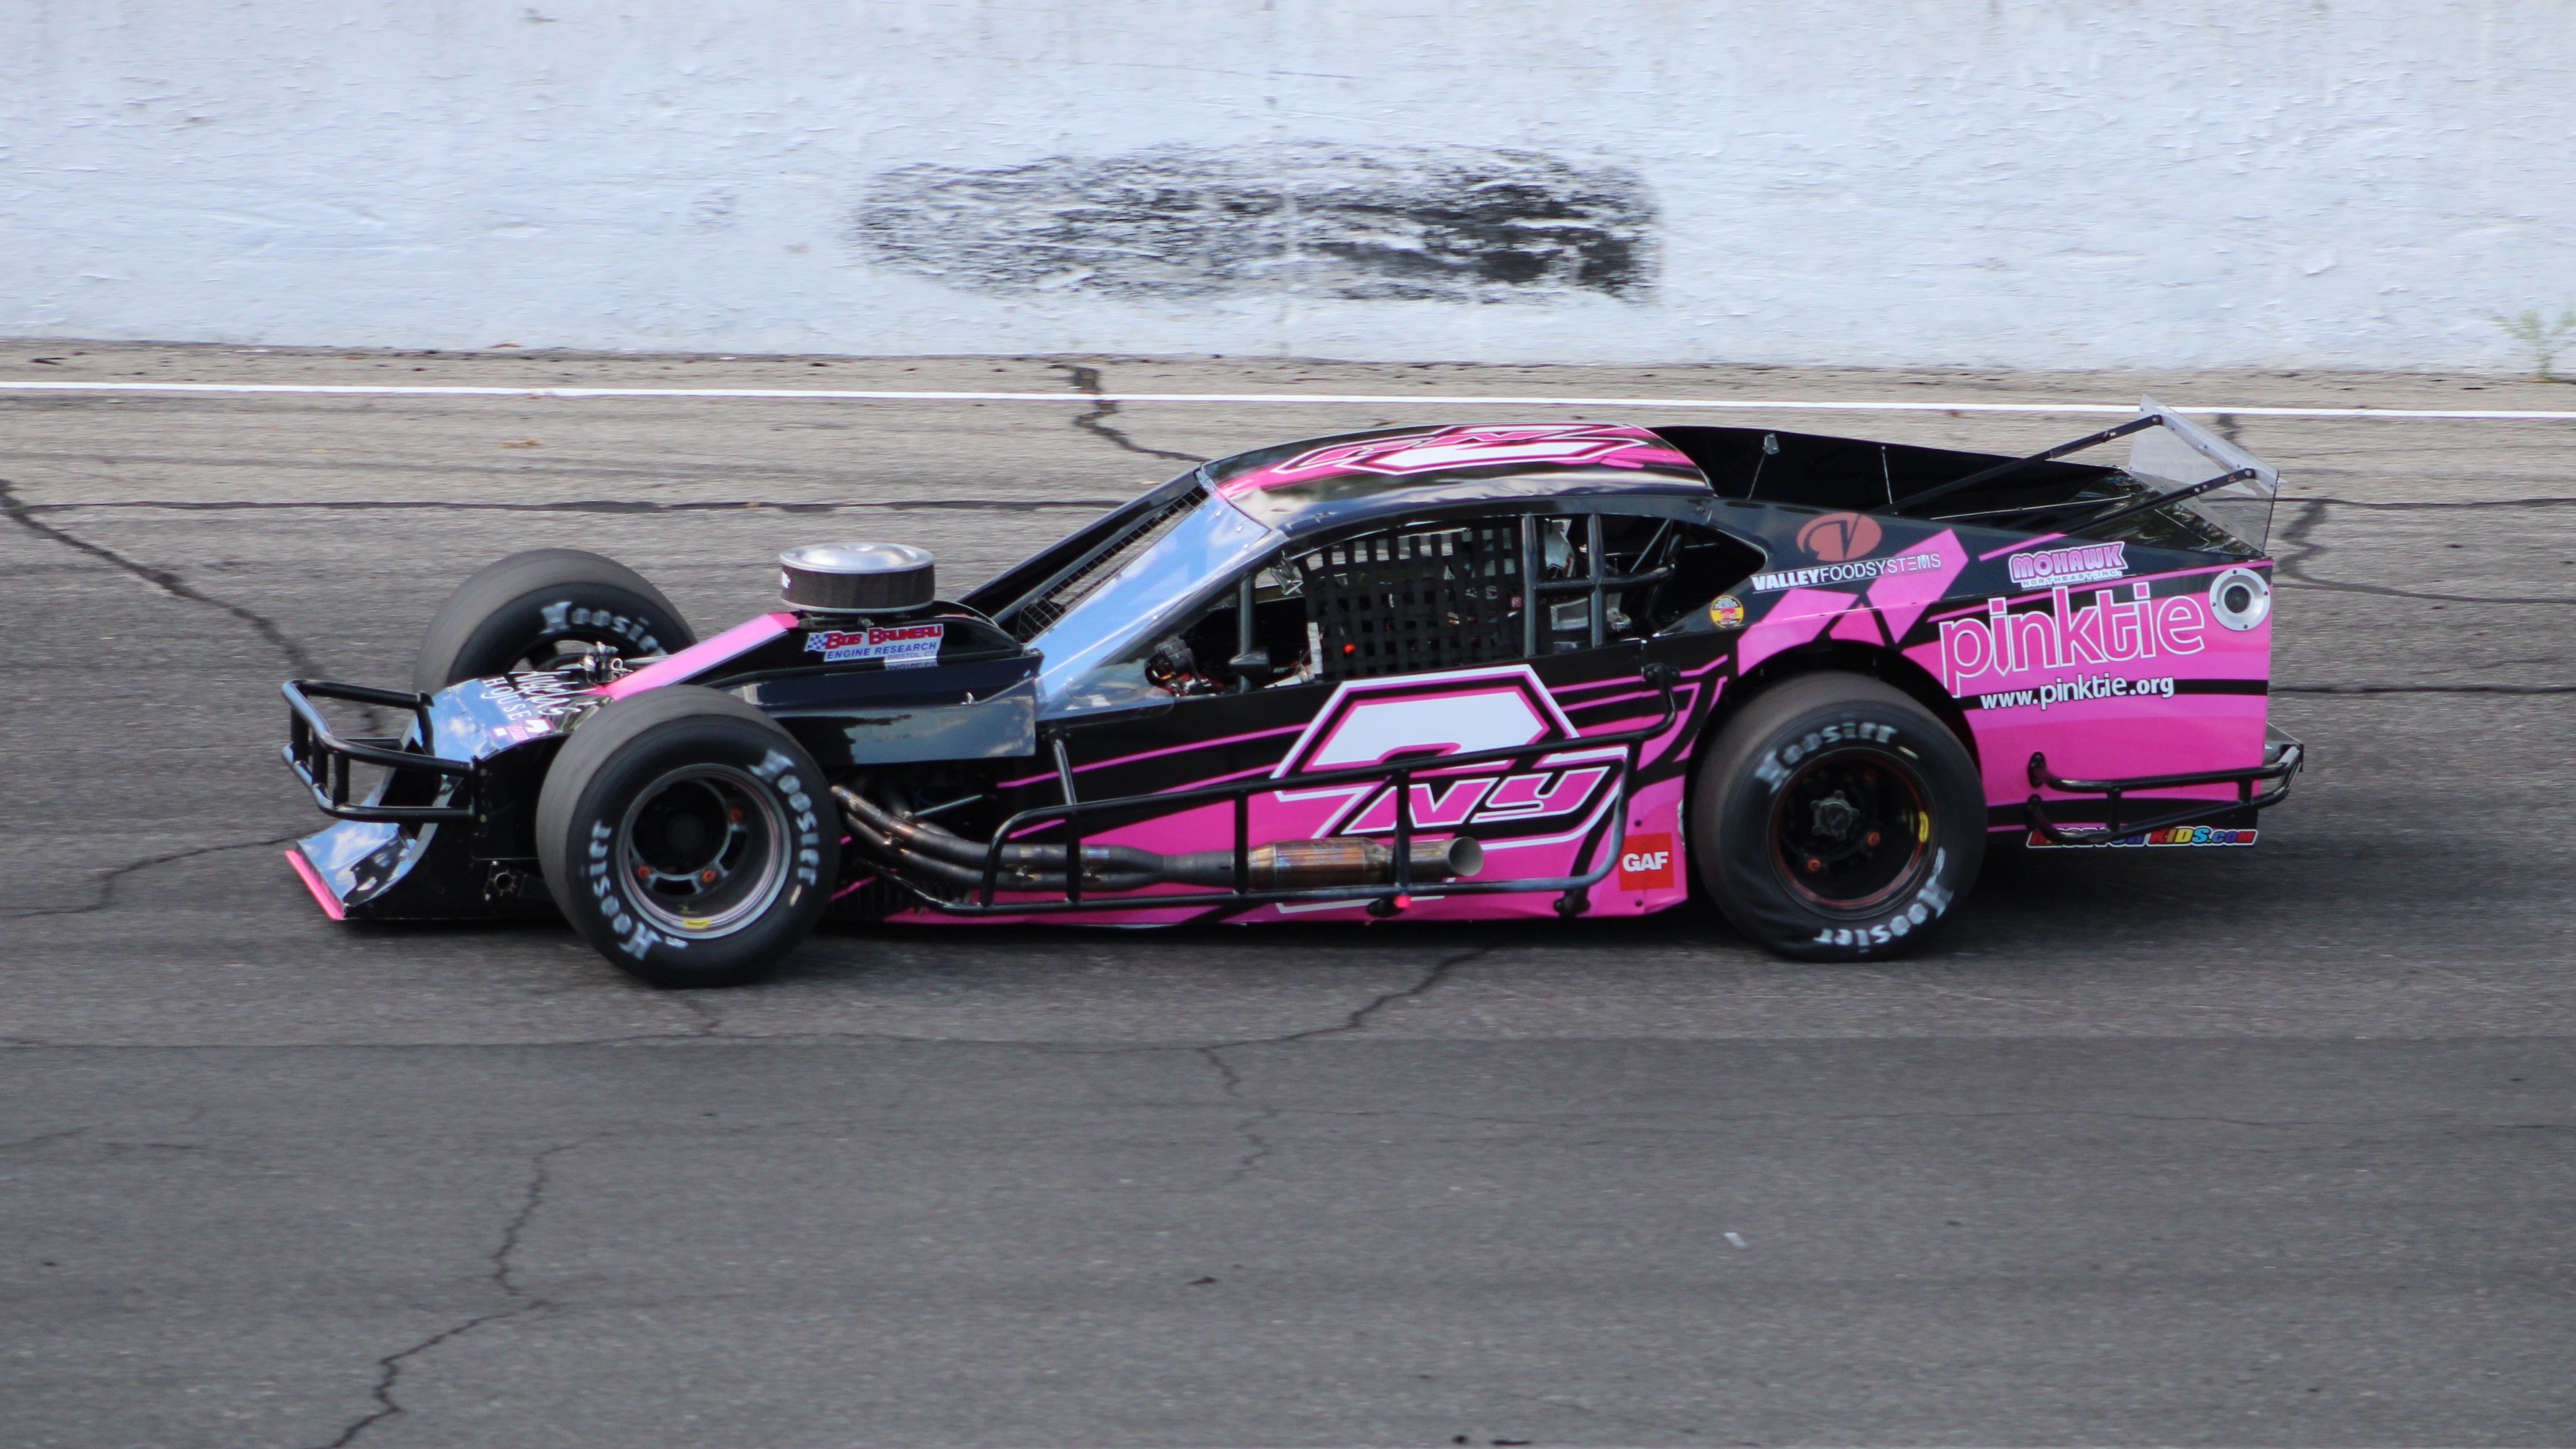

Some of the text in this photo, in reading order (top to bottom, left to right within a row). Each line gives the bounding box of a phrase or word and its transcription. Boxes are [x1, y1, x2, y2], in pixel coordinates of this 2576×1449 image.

[2011, 545, 2124, 579] MOHAWK
[827, 641, 937, 659] ENGINE RESEARCH
[1939, 582, 2205, 698] pinktie
[483, 676, 532, 720] HOUSE
[1980, 672, 2175, 710] www.pinktie.org
[1755, 713, 1898, 794] Hoosier
[748, 749, 819, 886] Hoosier
[580, 820, 662, 960] Hoosier
[1623, 851, 1669, 872] GAF
[1813, 874, 1953, 953] Hoosier
